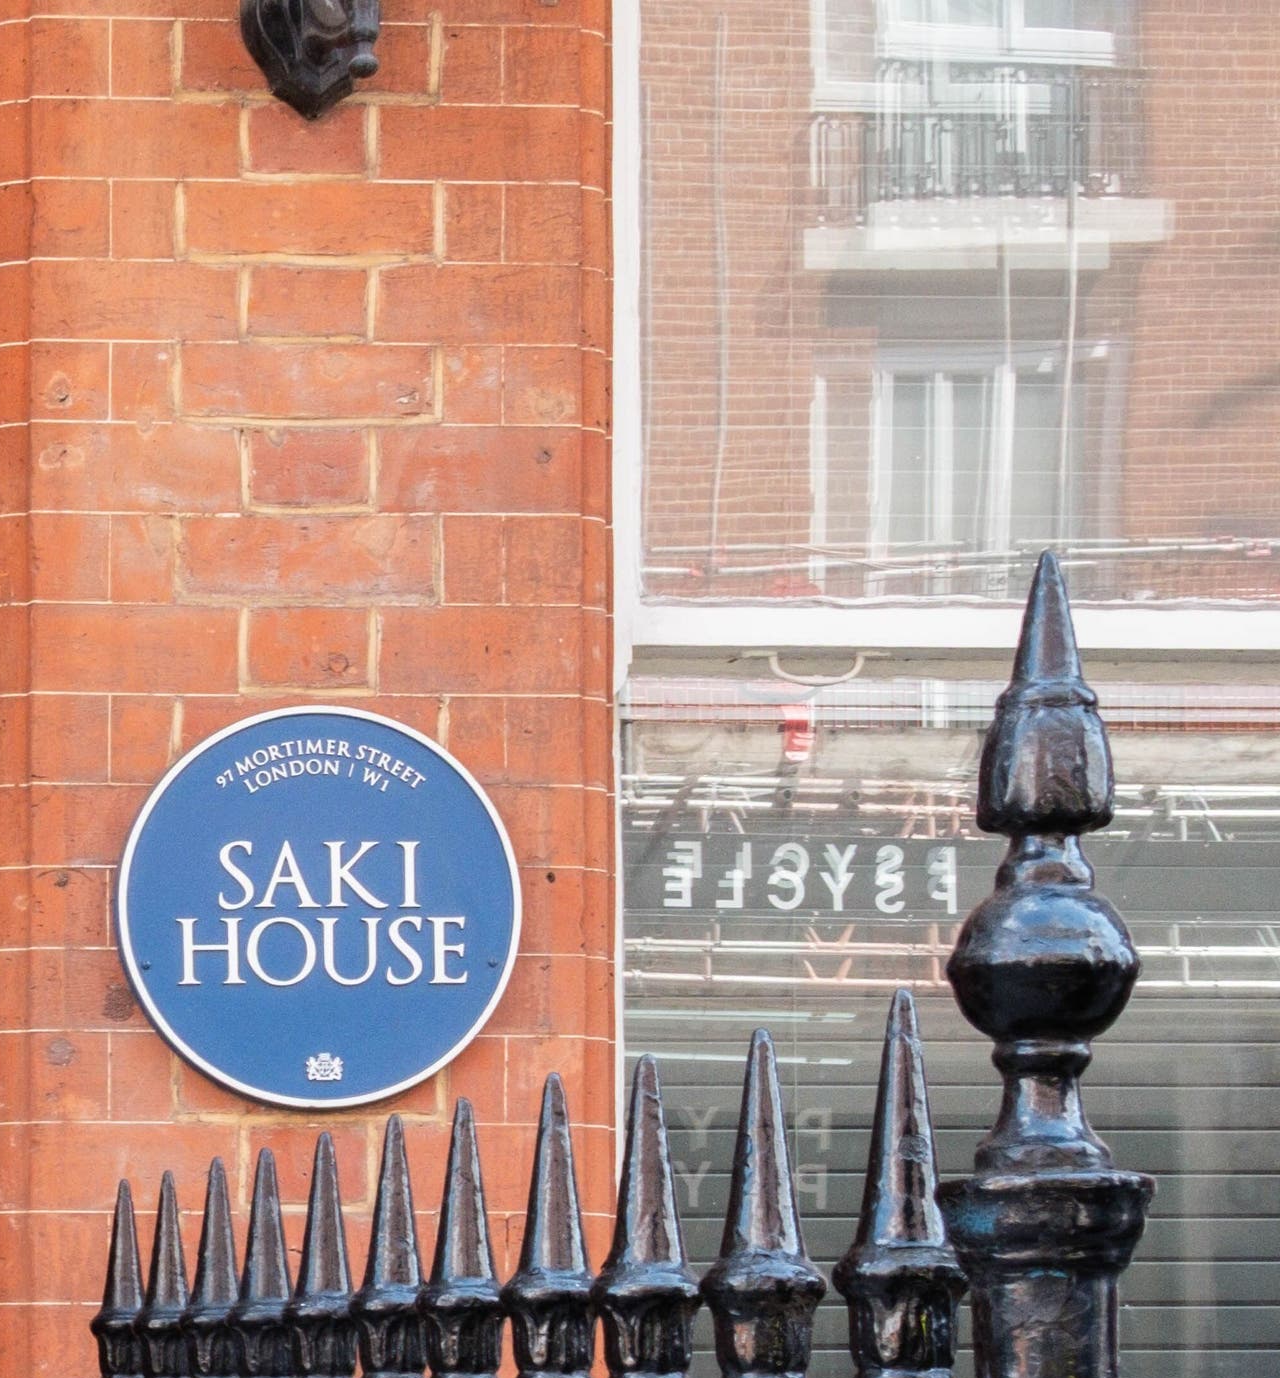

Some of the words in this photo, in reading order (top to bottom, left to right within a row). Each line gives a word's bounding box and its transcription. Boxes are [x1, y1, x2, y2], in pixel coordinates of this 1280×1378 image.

[215, 768, 234, 788] 97
[235, 738, 352, 777] MORTIMER
[355, 744, 427, 790] STREET
[243, 758, 341, 794] LONDON
[362, 766, 391, 793] W1
[217, 839, 423, 911] SAKI
[175, 916, 469, 987] HOUSE
